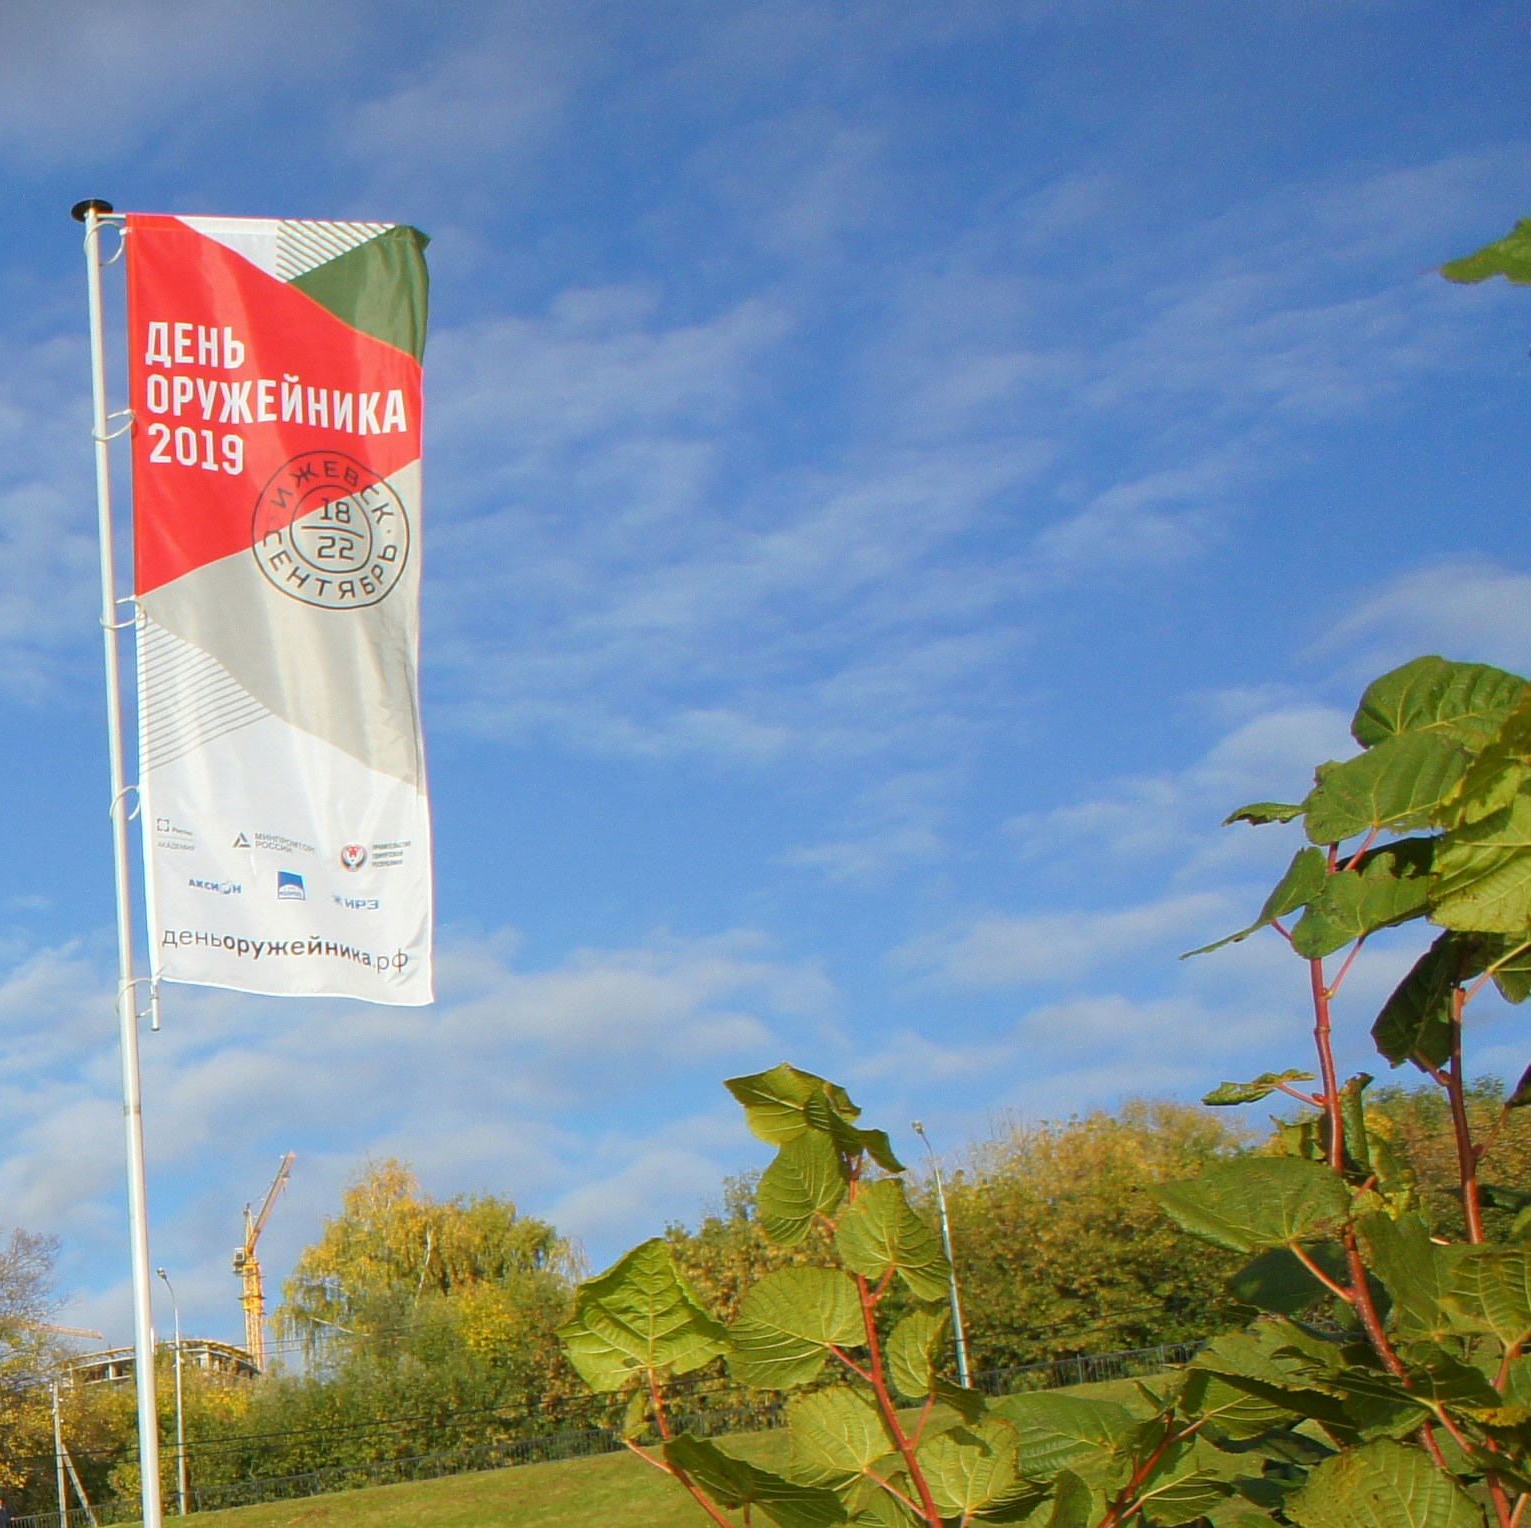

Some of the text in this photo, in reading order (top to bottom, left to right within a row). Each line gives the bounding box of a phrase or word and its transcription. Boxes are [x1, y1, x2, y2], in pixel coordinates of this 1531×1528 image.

[145, 321, 245, 369] ДЕНЬ
[146, 373, 408, 435] ОРУЖЕЙНИКА
[147, 422, 244, 475] 2019
[270, 461, 394, 525] ИЖЕВСК
[320, 497, 351, 524] 18
[263, 530, 398, 600] СЕНТЯБРЬ
[317, 536, 355, 561] 22
[188, 879, 242, 894] АКСИОН
[344, 898, 379, 910] ИРЗ
[162, 929, 409, 973] деньоружейника.рф
